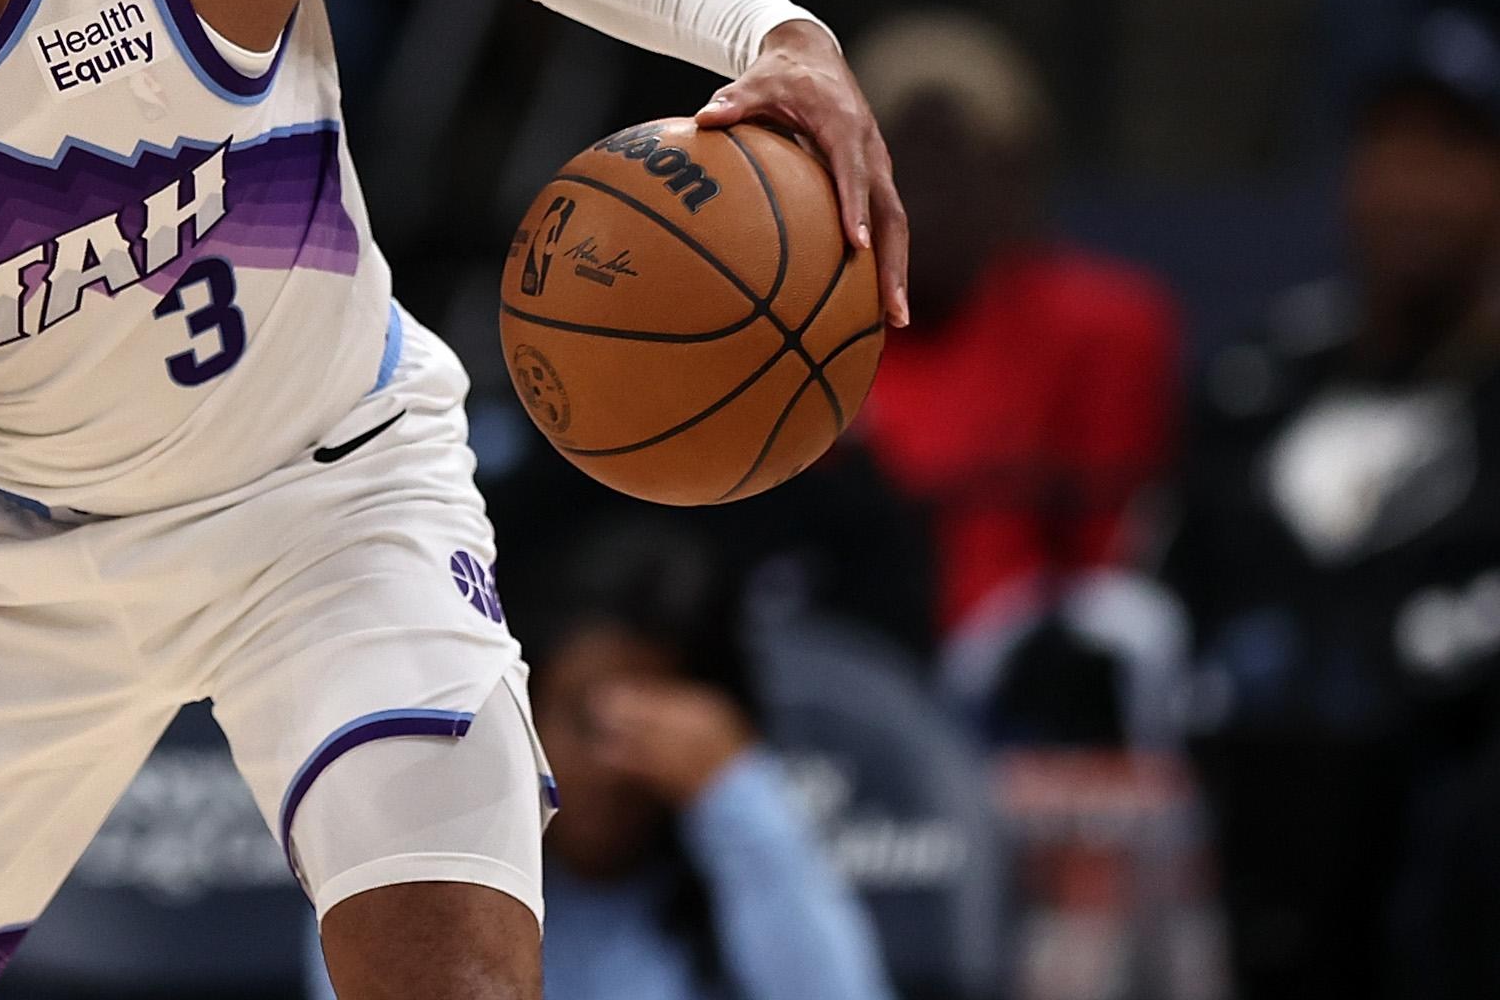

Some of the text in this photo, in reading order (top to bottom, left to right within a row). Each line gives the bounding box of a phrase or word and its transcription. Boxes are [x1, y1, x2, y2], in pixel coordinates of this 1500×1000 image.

[37, 1, 145, 63] Health
[50, 31, 154, 91] Equity
[153, 256, 247, 387] 3
